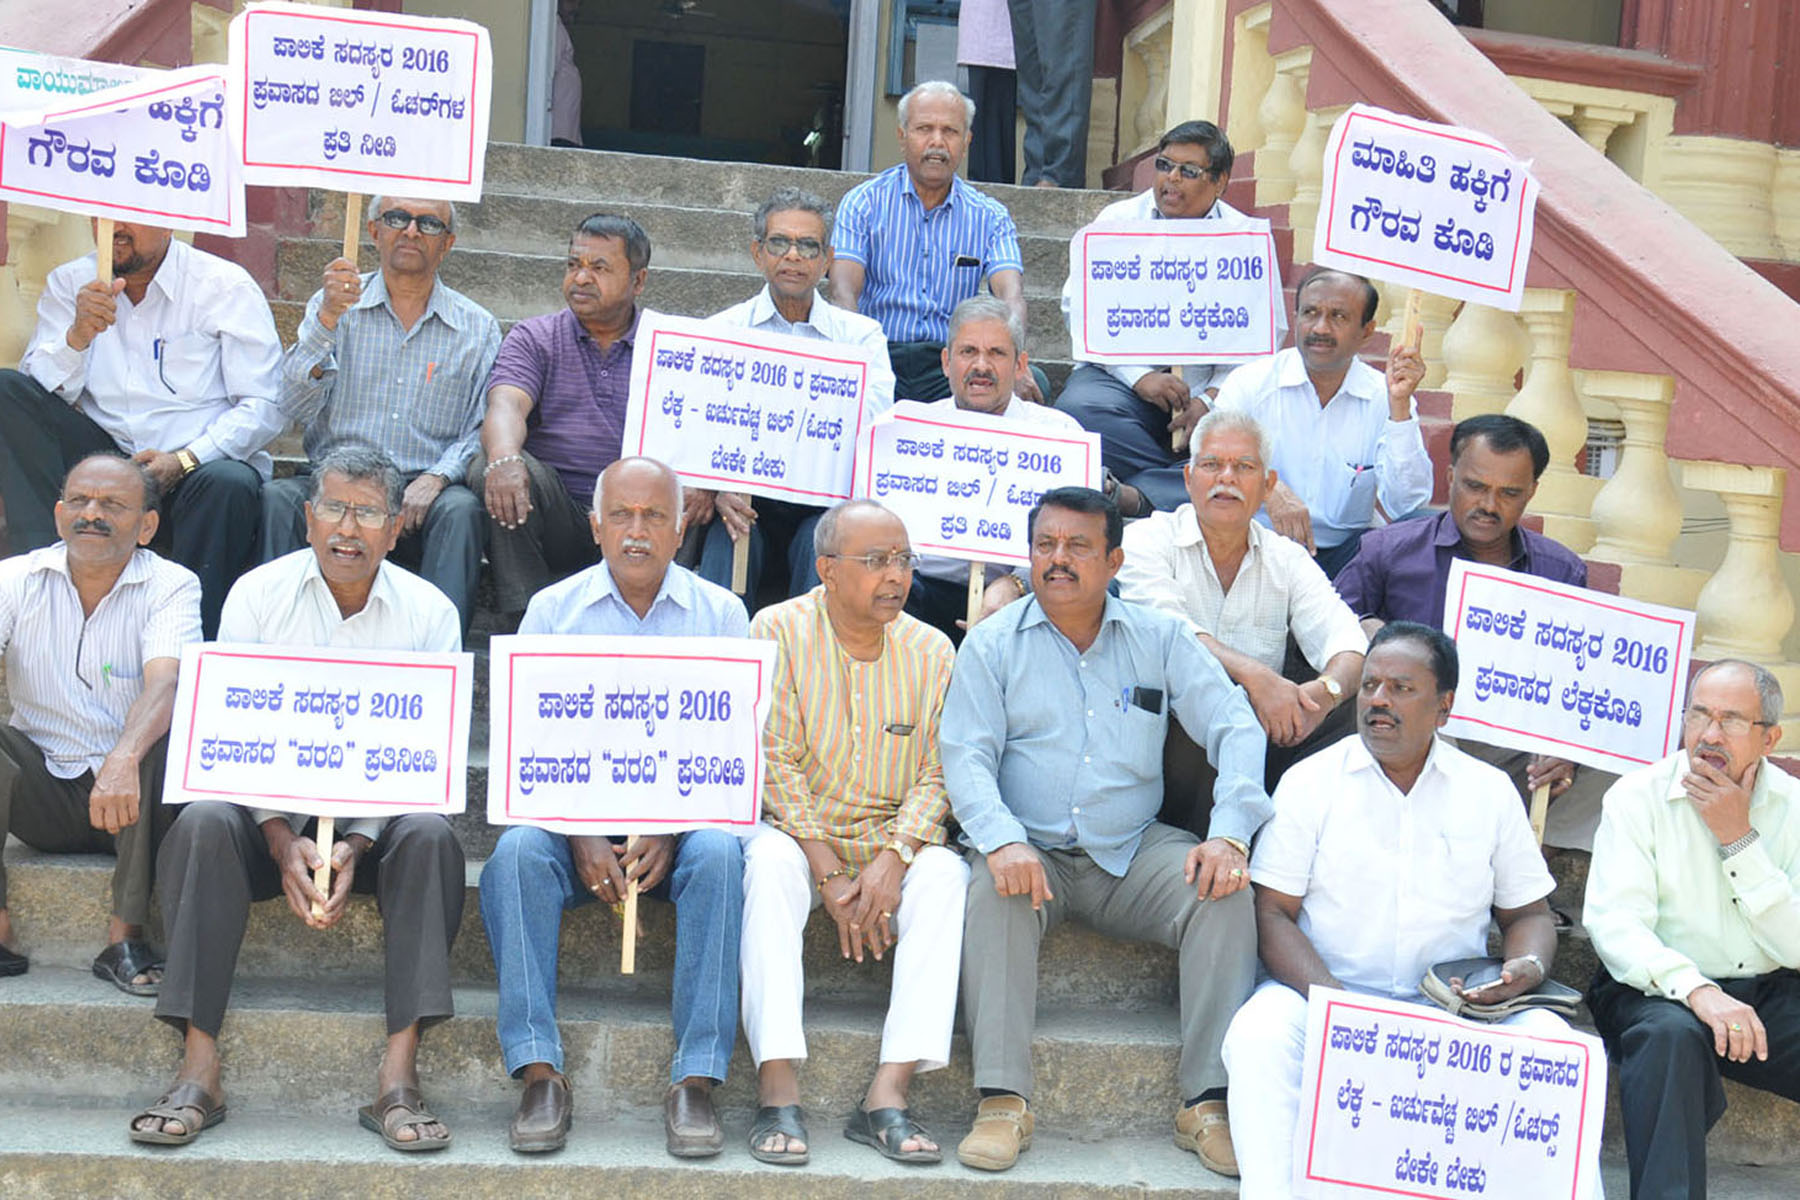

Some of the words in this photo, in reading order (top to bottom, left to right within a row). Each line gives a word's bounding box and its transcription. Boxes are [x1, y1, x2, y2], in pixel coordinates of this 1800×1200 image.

[273, 35, 325, 60] ಪಾಲಿಕೆ
[334, 42, 393, 79] ಸದಸ್ಯರ
[402, 47, 449, 73] 2016
[253, 80, 320, 109] ಪ್ರವಾಸದ
[329, 84, 364, 108] ಬಿಲ್
[28, 127, 117, 178] ಗೌರವ
[134, 149, 211, 192] ಕೊಡಿ
[323, 128, 351, 160] ಪ್ರತಿ
[360, 134, 396, 157] ನೀಡಿ
[1352, 138, 1436, 184] ಮಾಹಿತಿ
[1449, 160, 1512, 214] ಹಕ್ಕಿಗೆ
[1350, 196, 1422, 243] ಗೌರವ
[1434, 218, 1494, 261] ಕೊಡಿ
[1091, 254, 1141, 280] ಪಾಲಿಕೆ
[1150, 256, 1208, 292] ಸದಸ್ಯರ
[1216, 256, 1264, 282] 2016
[1107, 301, 1171, 338] ಪ್ರವಾಸದ
[1179, 302, 1250, 341] ಲೆಕ್ಕಕೊಡಿ
[656, 346, 696, 372] ಪಾಲಿಕೆ
[700, 355, 746, 392] ಸದಸ್ಯರ
[750, 361, 787, 387] 2016
[793, 368, 805, 390] ರ
[809, 373, 858, 401] ಪ್ರವಾಸದ
[662, 390, 684, 429] ಲೆಕ್ಕ
[766, 409, 795, 432] ಬಿಲ್
[711, 444, 747, 474] ಬೇಕೇ
[752, 451, 786, 479] ಬೇಕು
[896, 438, 944, 459] ಪಾಲಿಕೆ
[953, 445, 1008, 476] ಸದಸ್ಯರ
[1018, 451, 1061, 474] 2016
[876, 471, 938, 496] ಪ್ರವಾಸದ
[947, 479, 980, 498] ಬಿಲ್
[941, 515, 967, 540] ಪ್ರತಿ
[976, 519, 1012, 540] ನೀಡಿ
[1466, 605, 1527, 640] ಪಾಲಿಕೆ
[1535, 618, 1605, 672] ಸದಸ್ಯರ
[1612, 637, 1668, 674] 2016
[225, 683, 284, 711] ಪಾಲಿಕೆ
[293, 688, 360, 730] ಸದಸ್ಯರ
[370, 692, 423, 720] 2016
[538, 684, 594, 719] ಪಾಲಿಕೆ
[605, 689, 669, 738] ಸದಸ್ಯರ
[680, 690, 731, 721] 2016
[1475, 664, 1552, 705] ಪ್ರವಾಸದ
[1561, 680, 1642, 731] ಲೆಕ್ಕಕೊಡಿ
[200, 736, 276, 771] ಪ್ರವಾಸದ
[365, 747, 437, 782] ಪ್ರತಿನೀಡಿ
[520, 750, 591, 795] ಪ್ರವಾಸದ
[678, 754, 745, 797] ಪ್ರತಿನೀಡಿ
[1331, 1024, 1379, 1054] ಪಾಲಿಕೆ
[1385, 1029, 1440, 1080] ಸದಸ್ಯರ
[1446, 1040, 1492, 1073] 2016
[1499, 1052, 1512, 1076] ರ
[1518, 1053, 1580, 1091] ಪ್ರವಾಸದ
[1337, 1079, 1364, 1128] ಲೆಕ್ಕ
[1465, 1104, 1499, 1133] ಬಿಲ್
[1395, 1148, 1439, 1186] ಬೇಕೇ
[1446, 1156, 1487, 1194] ಬೇಕು
